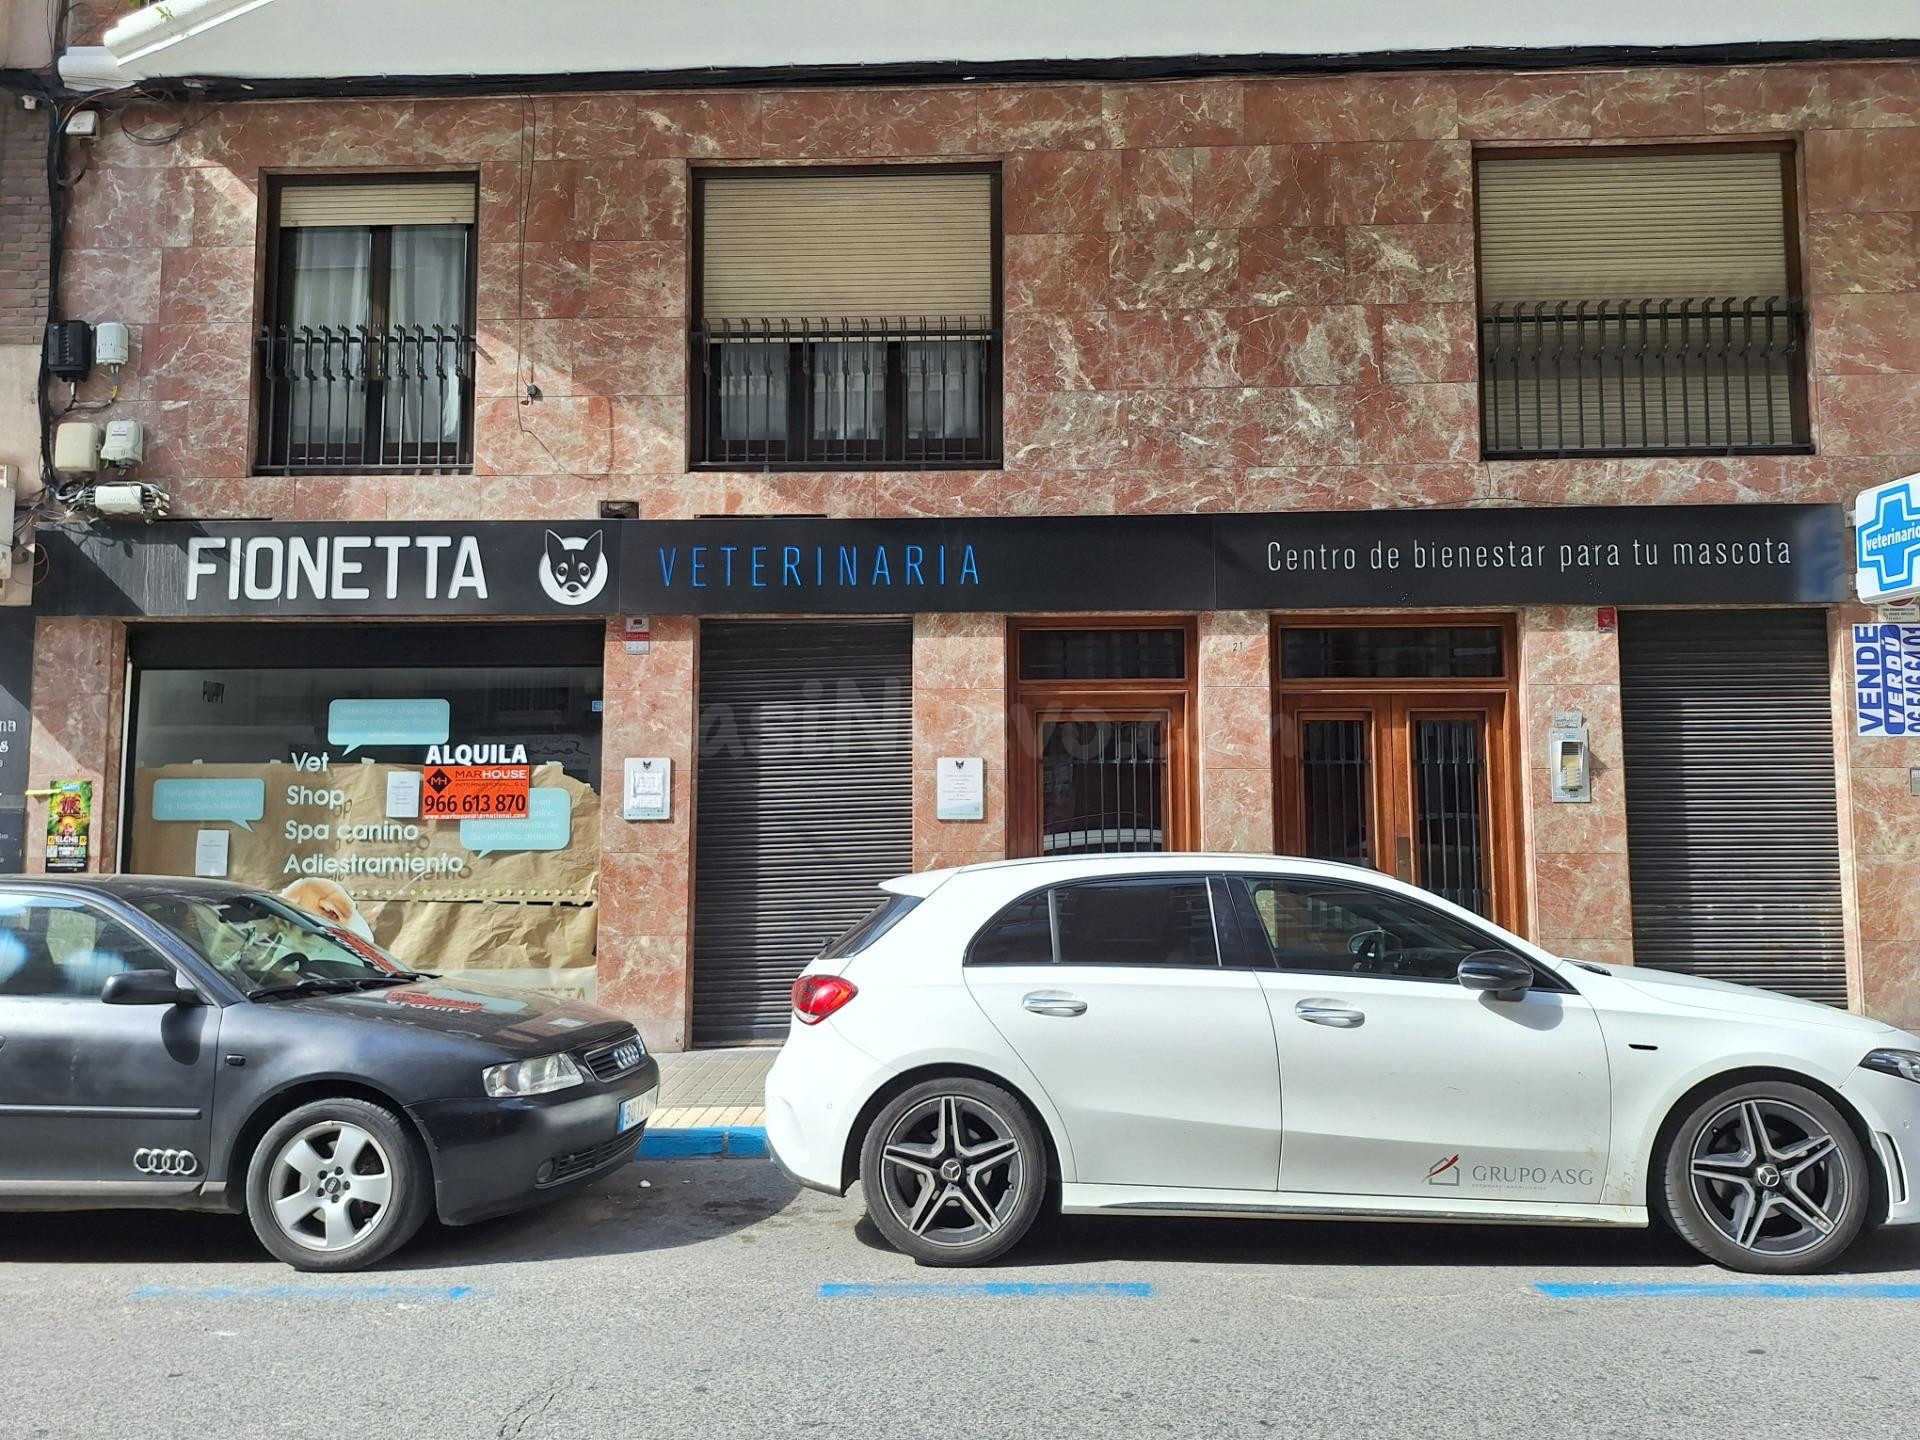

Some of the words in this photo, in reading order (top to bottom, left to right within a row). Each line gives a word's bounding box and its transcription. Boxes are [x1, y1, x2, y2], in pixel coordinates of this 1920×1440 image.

[1866, 522, 1920, 551] veterinario
[657, 544, 979, 588] VETERINARIA
[1267, 541, 1357, 571] Centro
[1370, 539, 1401, 569] de
[1413, 539, 1546, 568] bienestar
[1560, 543, 1621, 573] para
[1632, 538, 1658, 566] tu
[1672, 537, 1792, 565] mascota
[186, 536, 488, 600] FIONETTA
[1232, 641, 1244, 652] 21
[1855, 625, 1883, 733] VENDE
[1881, 636, 1905, 724] VERDÚ
[291, 751, 330, 773] Vet
[425, 743, 528, 766] ALQUILA
[455, 769, 527, 779] MARHOUSE
[286, 784, 345, 810] Shop
[424, 794, 458, 813] 966
[462, 794, 491, 812] 613
[495, 794, 526, 812] 870
[284, 819, 330, 844] Spa
[335, 820, 419, 842] canino
[282, 852, 465, 874] Adiestramiento
[1472, 1165, 1547, 1184] GRUPO
[1550, 1168, 1593, 1186] ASG
